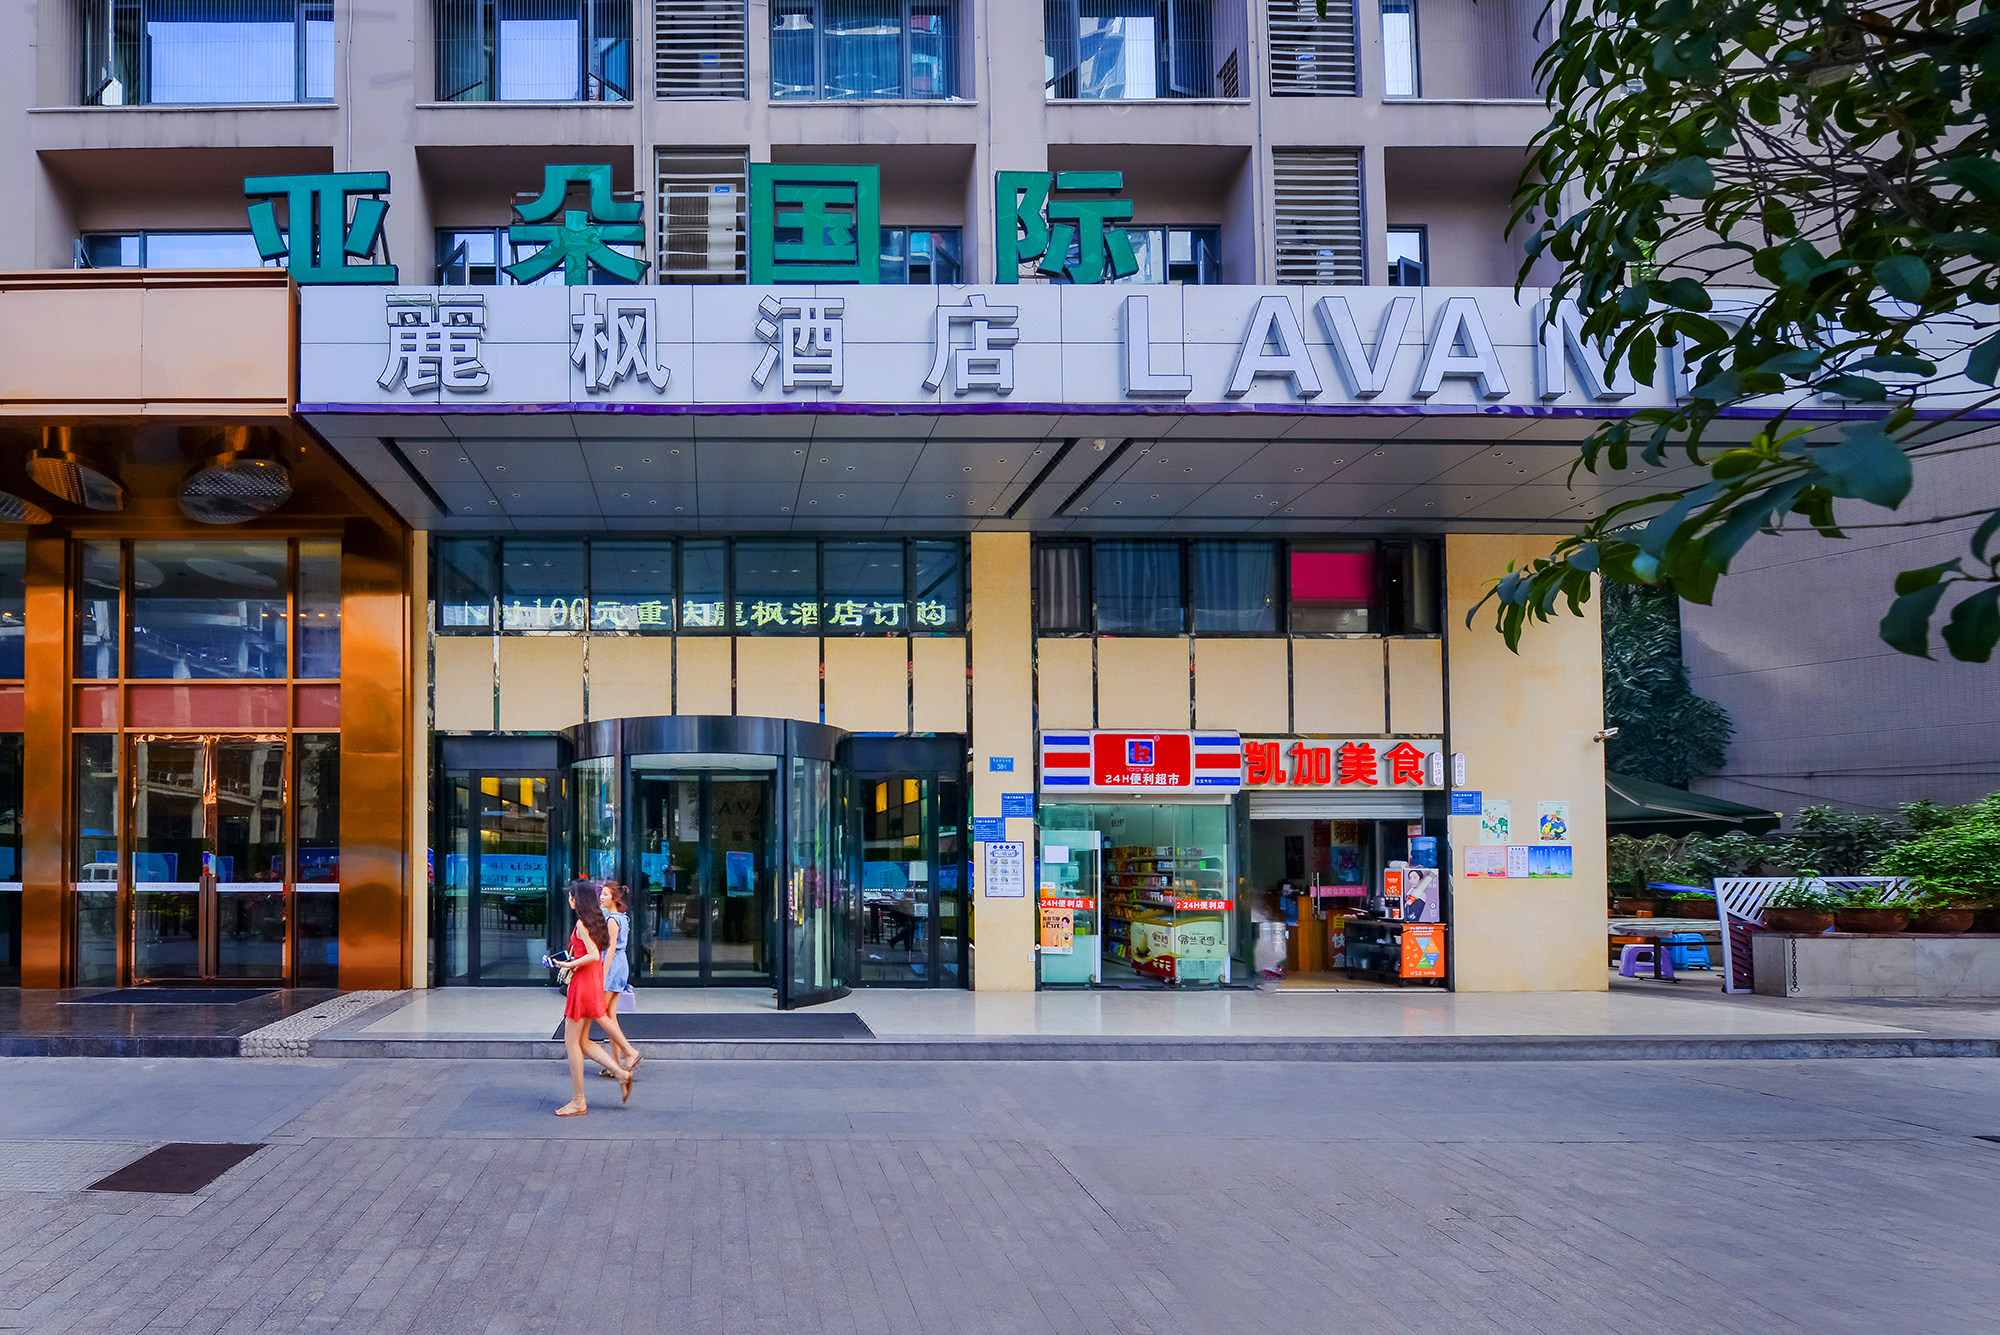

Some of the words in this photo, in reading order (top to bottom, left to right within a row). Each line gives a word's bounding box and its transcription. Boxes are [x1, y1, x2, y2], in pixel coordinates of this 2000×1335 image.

[244, 163, 1138, 285] 亚朵国际
[377, 293, 1019, 396] 麗枫酒店
[1244, 741, 1425, 786] 凯加美食
[1105, 773, 1180, 786] 24H便利超市
[1041, 899, 1083, 909] 24H便利店
[1183, 901, 1225, 910] 24H便利店
